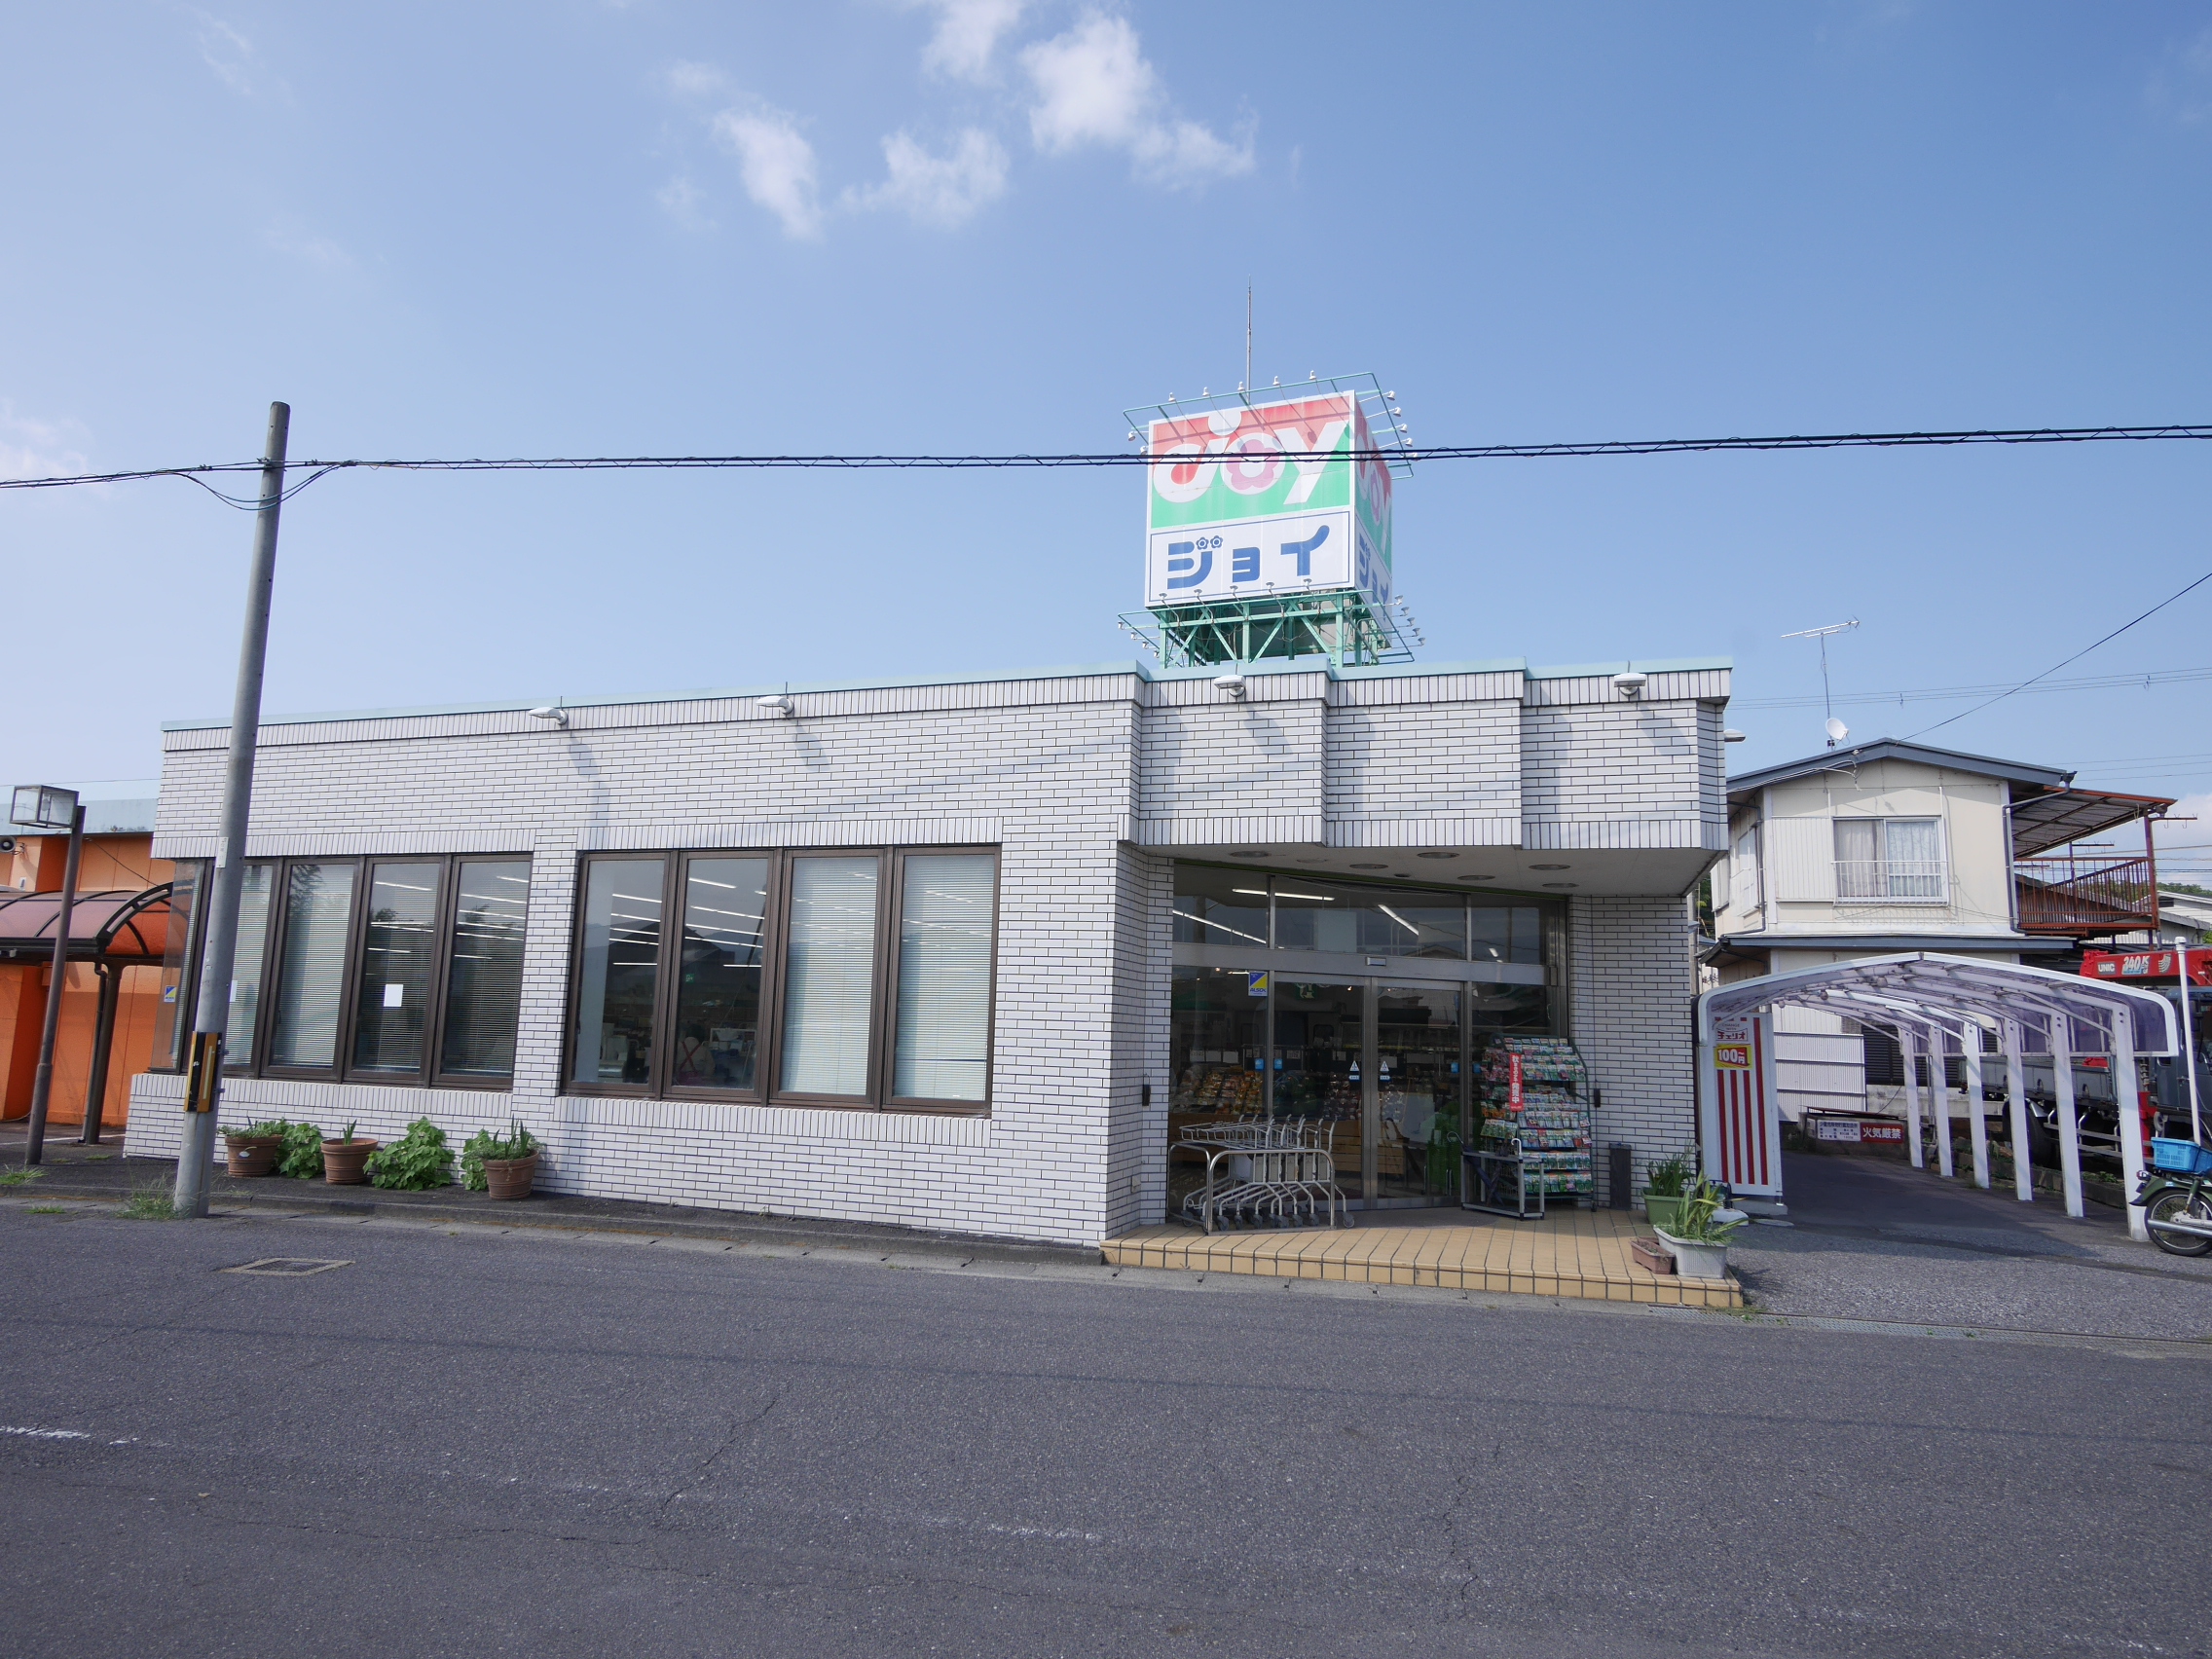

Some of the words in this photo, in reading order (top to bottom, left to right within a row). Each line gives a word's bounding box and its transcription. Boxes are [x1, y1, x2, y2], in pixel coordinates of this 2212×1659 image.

[1167, 525, 1330, 590] ジョイ
[2098, 963, 2115, 973] UNIC
[1717, 1031, 1745, 1040] チェリオ
[1862, 1126, 1901, 1139] 火気厳禁
